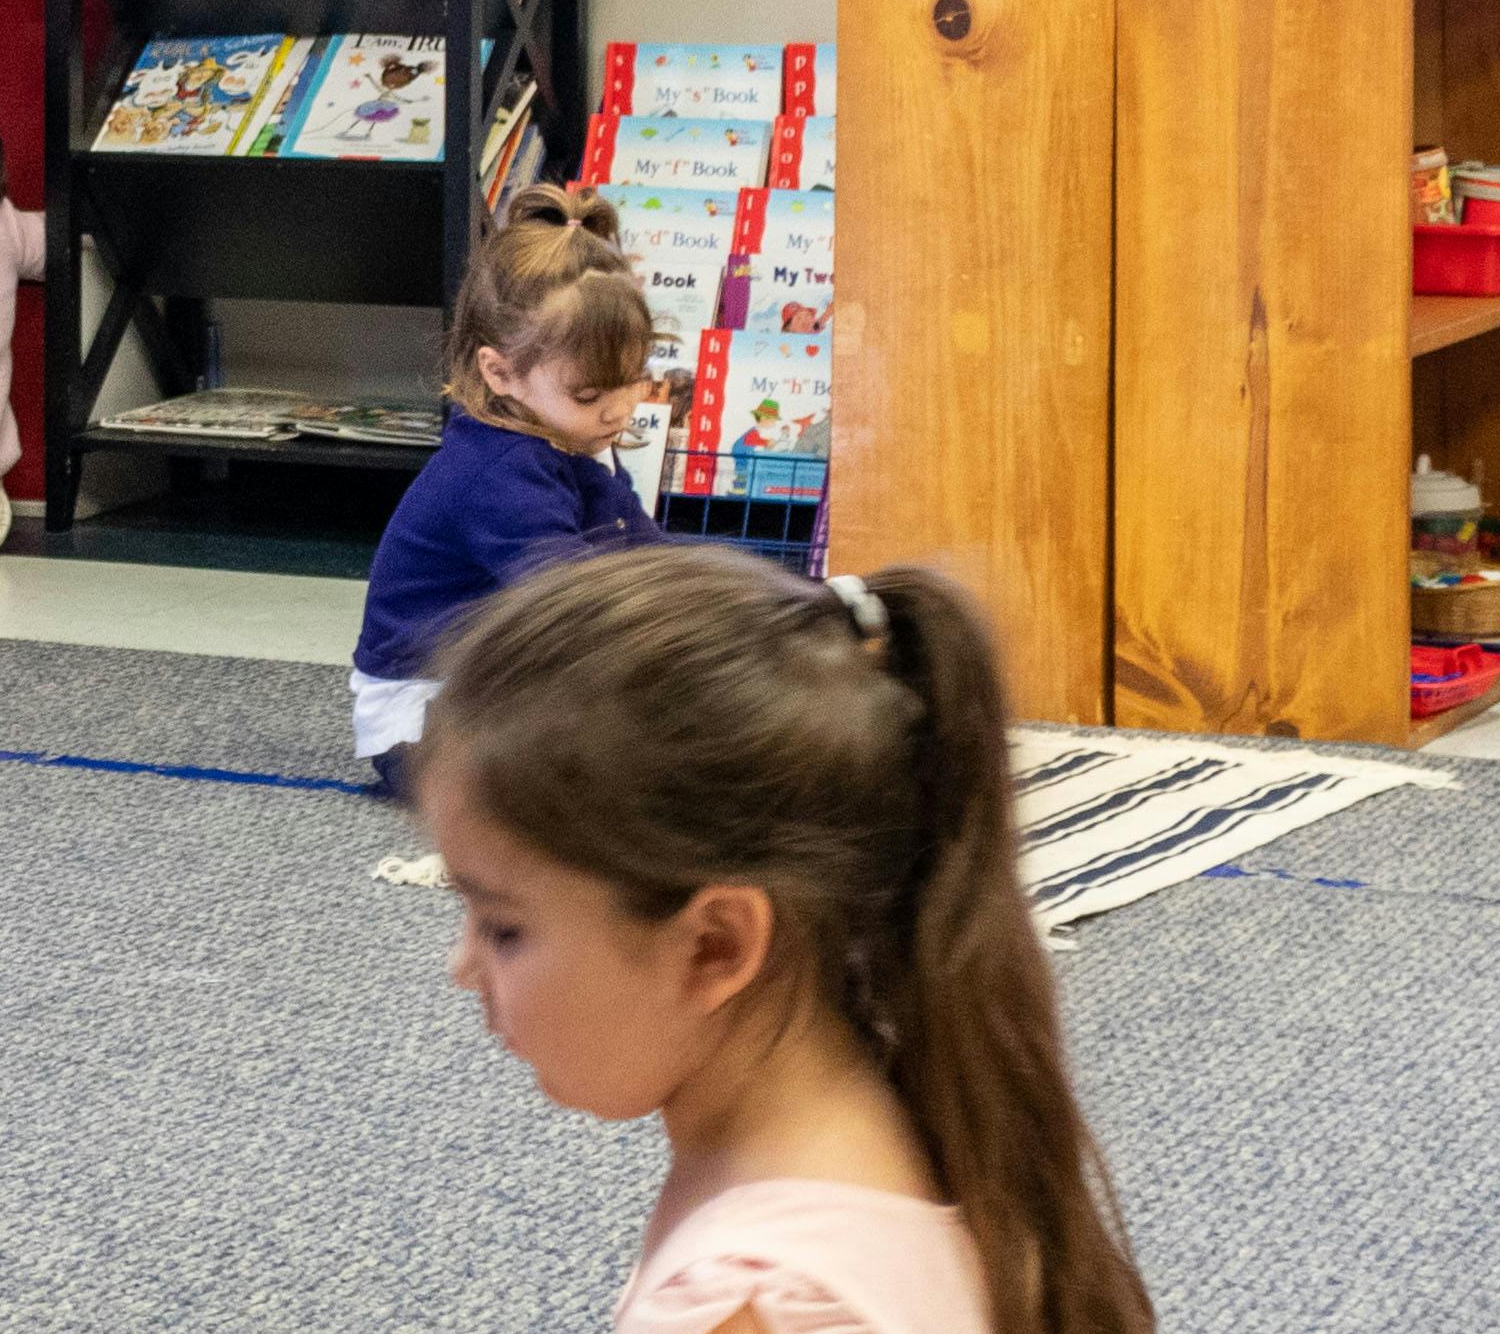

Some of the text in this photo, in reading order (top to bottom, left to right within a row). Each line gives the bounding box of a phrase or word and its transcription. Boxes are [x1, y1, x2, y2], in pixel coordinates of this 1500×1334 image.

[713, 87, 759, 104] Book
[692, 160, 737, 178] Book
[672, 231, 720, 249] Book
[651, 272, 696, 289] Book
[773, 267, 799, 287] My
